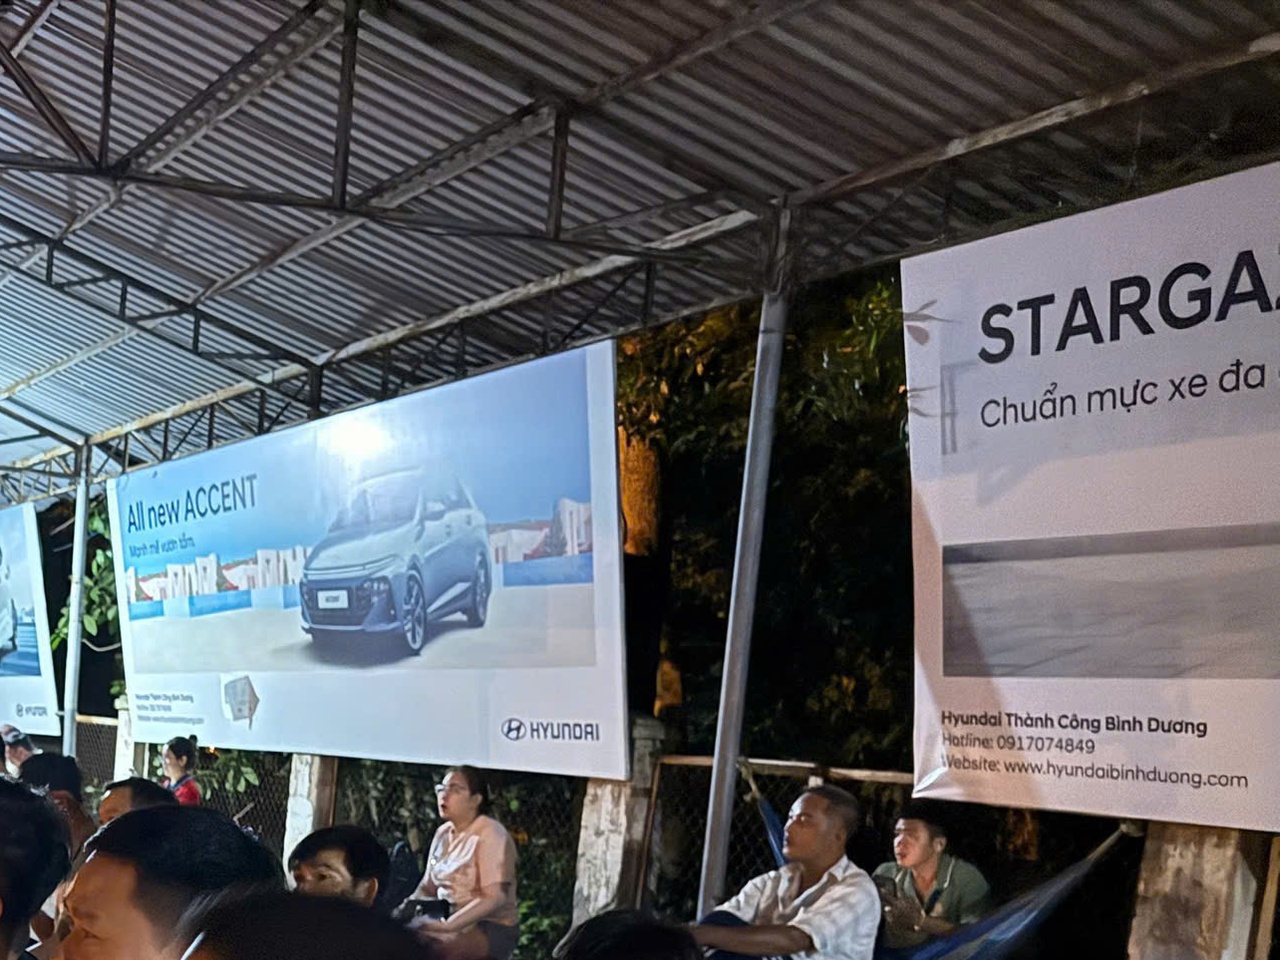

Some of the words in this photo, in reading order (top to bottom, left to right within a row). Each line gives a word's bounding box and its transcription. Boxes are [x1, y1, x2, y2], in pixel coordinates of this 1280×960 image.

[978, 249, 1280, 364] STARGA
[980, 382, 1077, 428] Chuẩn
[1087, 380, 1158, 413] mực
[1168, 373, 1208, 401] xe
[1218, 359, 1266, 393] đa
[127, 501, 146, 534] All
[148, 497, 180, 529] new
[184, 473, 257, 523] ACCENT
[530, 721, 600, 741] HYUNDAI
[941, 711, 1002, 727] Hyundai
[1005, 711, 1054, 728] Thành
[1057, 713, 1101, 734] Công
[1105, 715, 1143, 732] Bình
[1147, 717, 1208, 738] Dương
[942, 733, 994, 750] Hotline:
[996, 735, 1095, 754] 0917074849
[941, 753, 1000, 772] Website:
[1003, 757, 1248, 789] www.hyundaibinhduong.com
